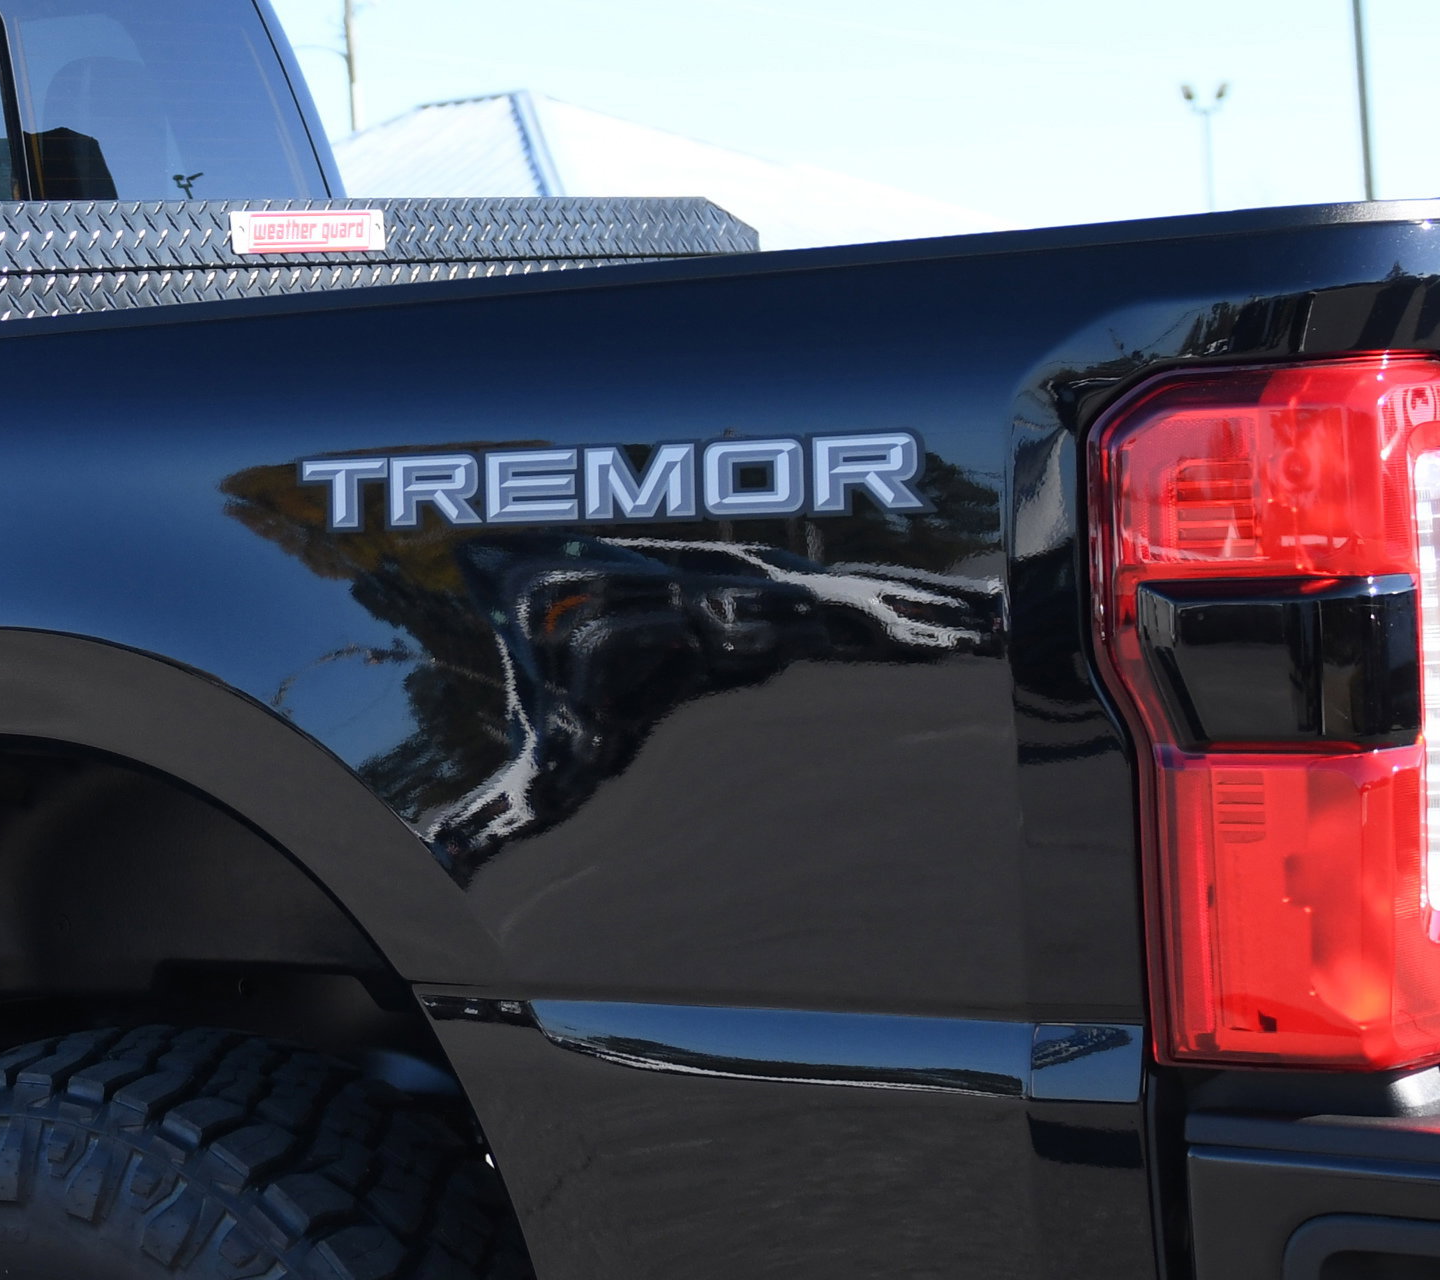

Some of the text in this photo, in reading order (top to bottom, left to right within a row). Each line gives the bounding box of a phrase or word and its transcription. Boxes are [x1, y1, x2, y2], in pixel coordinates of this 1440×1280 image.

[253, 219, 364, 243] weather guard
[300, 429, 924, 529] TREMOR
